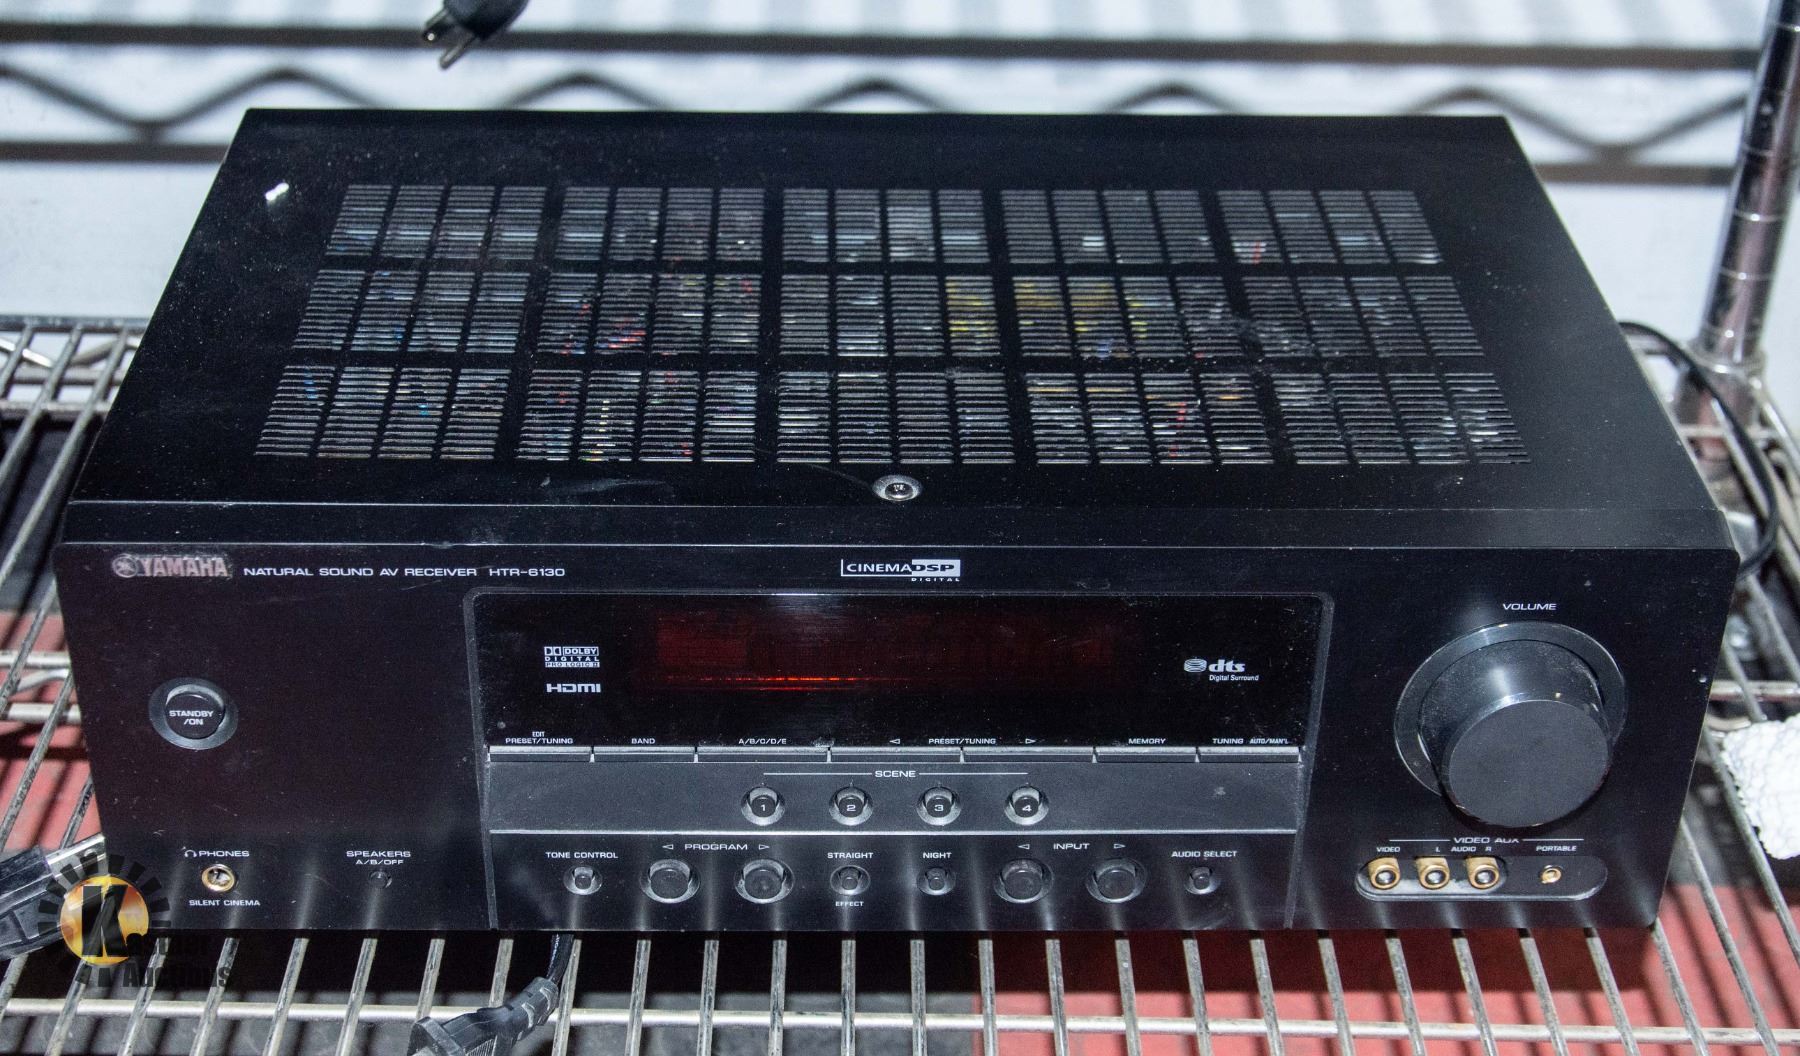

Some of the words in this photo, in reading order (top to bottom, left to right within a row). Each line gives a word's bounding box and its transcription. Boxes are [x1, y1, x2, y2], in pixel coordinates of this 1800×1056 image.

[140, 557, 228, 577] YAMAHA
[243, 567, 314, 576] NATURAL
[318, 567, 374, 577] SOUND
[379, 567, 399, 577] AV
[404, 567, 478, 577] RECEIVER
[488, 567, 566, 577] HTR-6130
[1502, 603, 1557, 611] VOLUME
[563, 647, 598, 656] DOLBY
[1208, 659, 1246, 673] dts
[1208, 674, 1230, 683] Digital
[1230, 674, 1260, 682] Surround
[546, 683, 602, 693] HDMI
[168, 709, 214, 717] STANDBY
[184, 718, 205, 726] /ON
[505, 737, 574, 745] PRESET/TUNING
[631, 737, 656, 745] BAND
[738, 737, 787, 745] A/B/C/D/E
[928, 737, 997, 745] PRESET/TUNING
[1128, 737, 1167, 745] MEMORY
[1212, 737, 1244, 745] TUNING
[874, 770, 917, 778] SCENE
[760, 804, 766, 812] 1
[846, 804, 857, 812] 2
[934, 804, 944, 812] 3
[1021, 804, 1032, 812] 4
[1453, 836, 1491, 844] VIDEO
[684, 843, 748, 851] PROGRAM
[1053, 842, 1090, 850] INPUT
[1450, 845, 1477, 853] AUDIO
[198, 850, 250, 858] PHONES
[346, 850, 412, 858] SPEAKERS
[545, 851, 571, 859] TONE
[573, 851, 619, 859] CONTROL
[827, 851, 874, 860] STRAIGHT
[922, 851, 952, 859] NIGHT
[1171, 850, 1201, 858] AUDIO
[1203, 850, 1238, 858] SELECT
[223, 899, 261, 907] CINEMA
